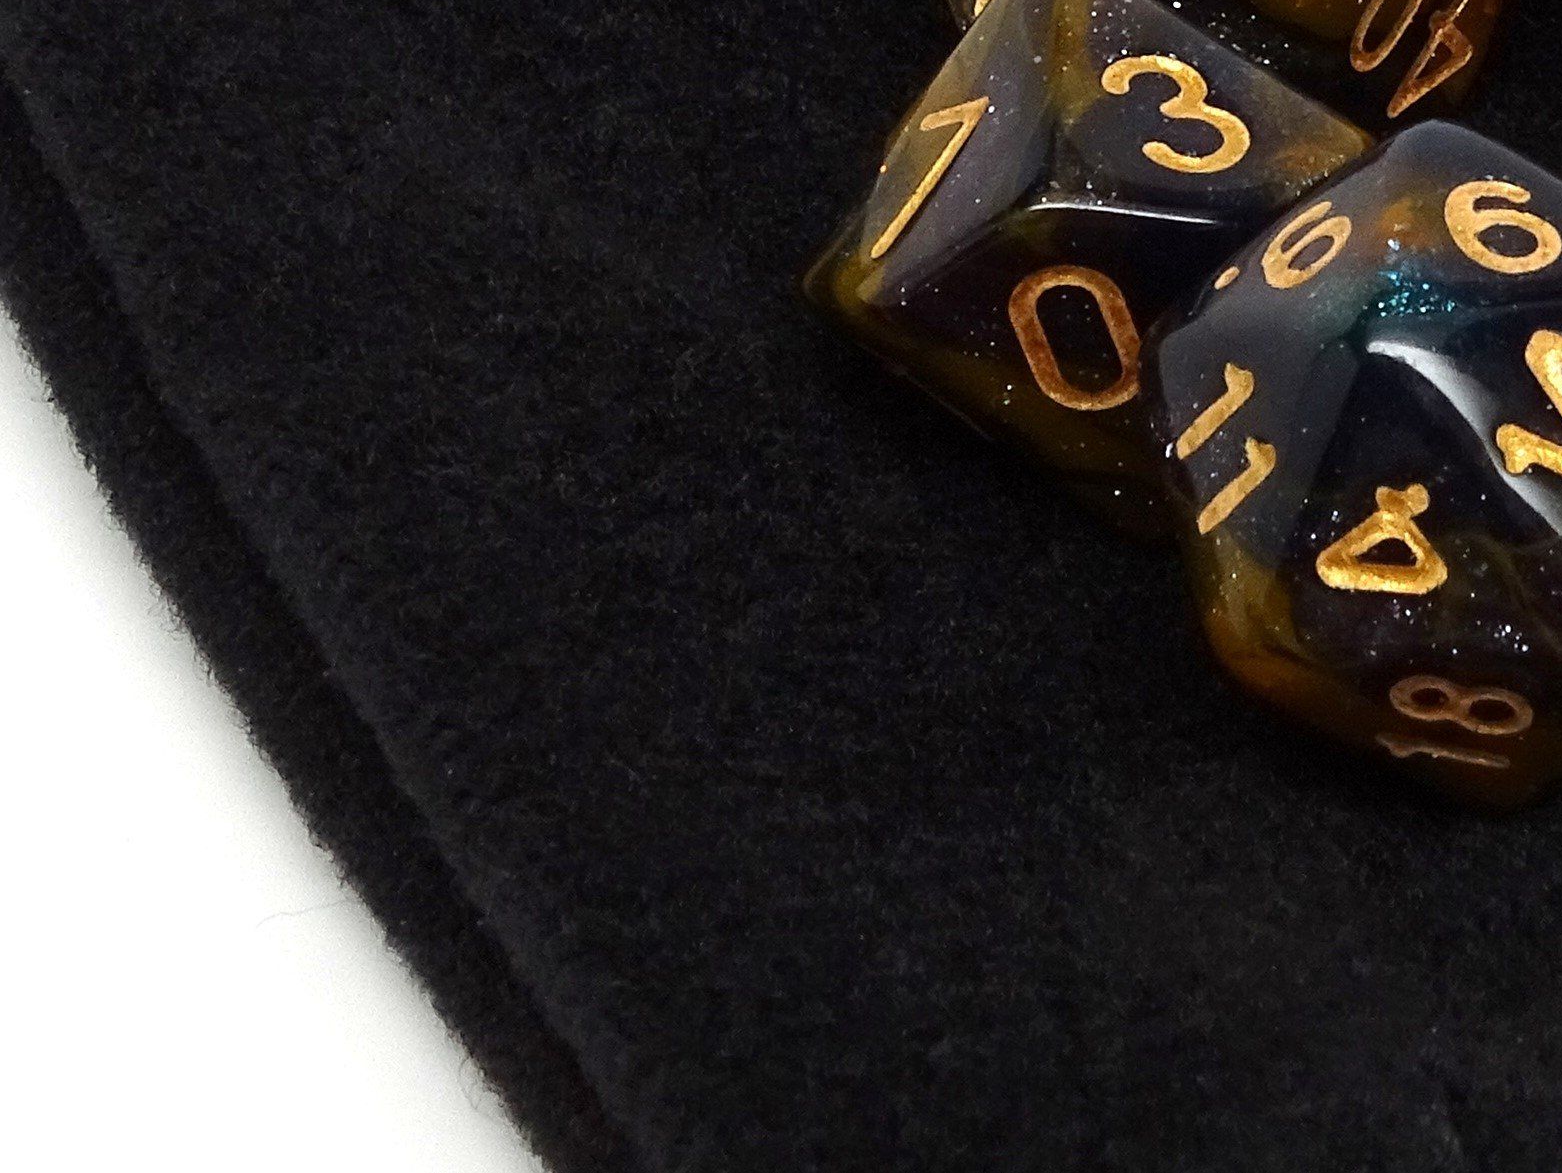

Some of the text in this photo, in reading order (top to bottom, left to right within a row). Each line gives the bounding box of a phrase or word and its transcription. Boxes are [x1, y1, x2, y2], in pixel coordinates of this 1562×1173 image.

[1101, 54, 1251, 174] 3
[1008, 265, 1140, 411] 0
[1176, 362, 1276, 534] 11
[1315, 484, 1447, 594] 4
[1375, 674, 1534, 769] 18
